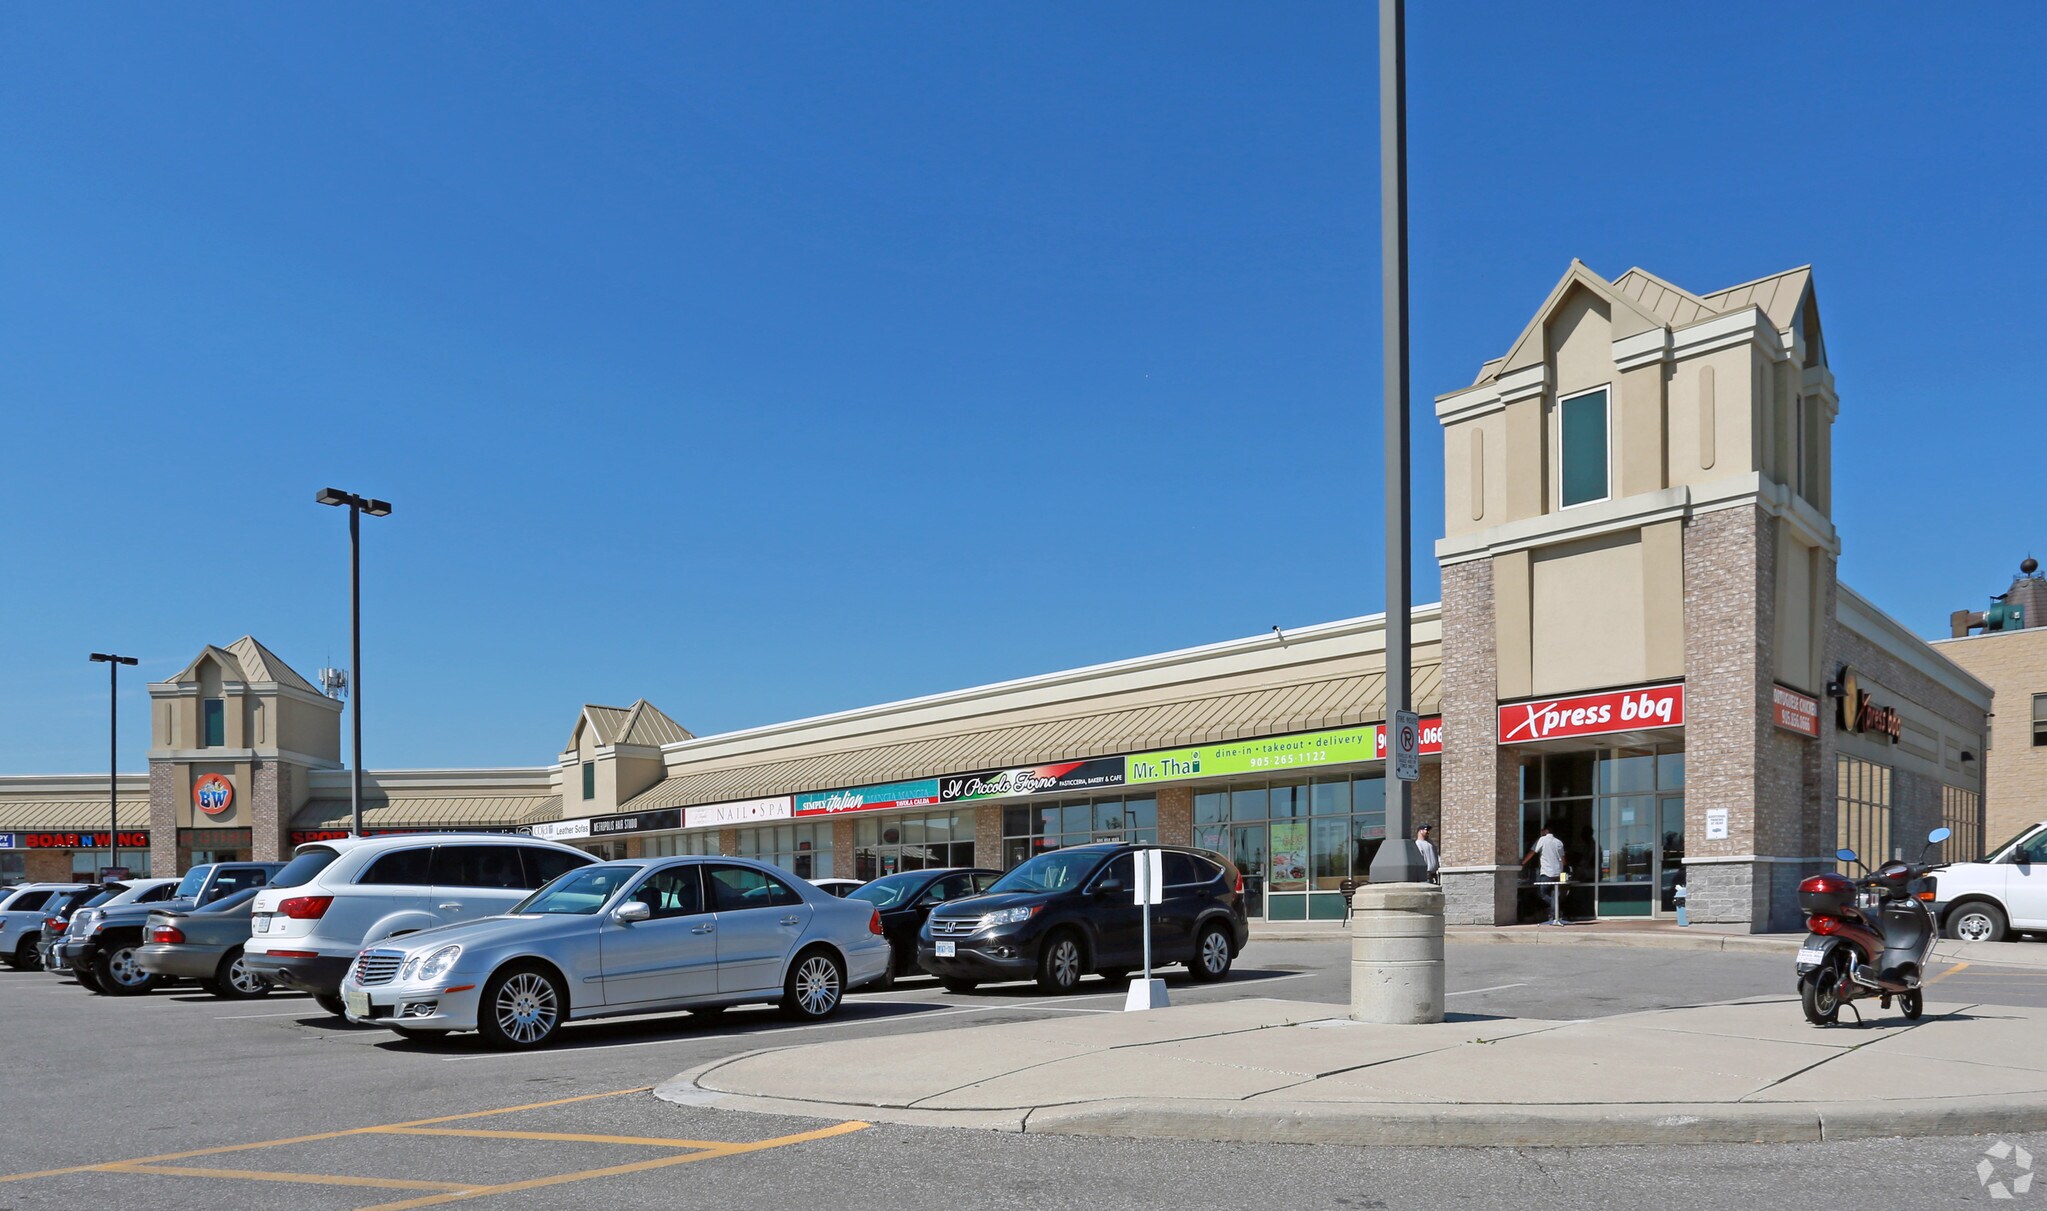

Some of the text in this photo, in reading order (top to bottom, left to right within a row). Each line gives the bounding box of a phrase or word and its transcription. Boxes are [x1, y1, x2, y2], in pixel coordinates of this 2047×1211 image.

[1505, 693, 1674, 739] Xpress bbq
[1215, 735, 1363, 759] dine-in takeout delivery
[1088, 776, 1104, 784] BAKERY
[1132, 762, 1159, 780] Mr.
[964, 774, 1011, 797] Piccolo
[1013, 771, 1057, 792] Forno
[198, 790, 228, 809] BW
[802, 800, 827, 811] SIMPLY
[825, 790, 864, 812] italian
[716, 807, 747, 821] NAIL
[760, 802, 784, 817] SPA
[556, 824, 588, 836] Leather Sofas
[624, 818, 637, 829] STUDIO
[26, 833, 147, 847] BOAR N WNG
